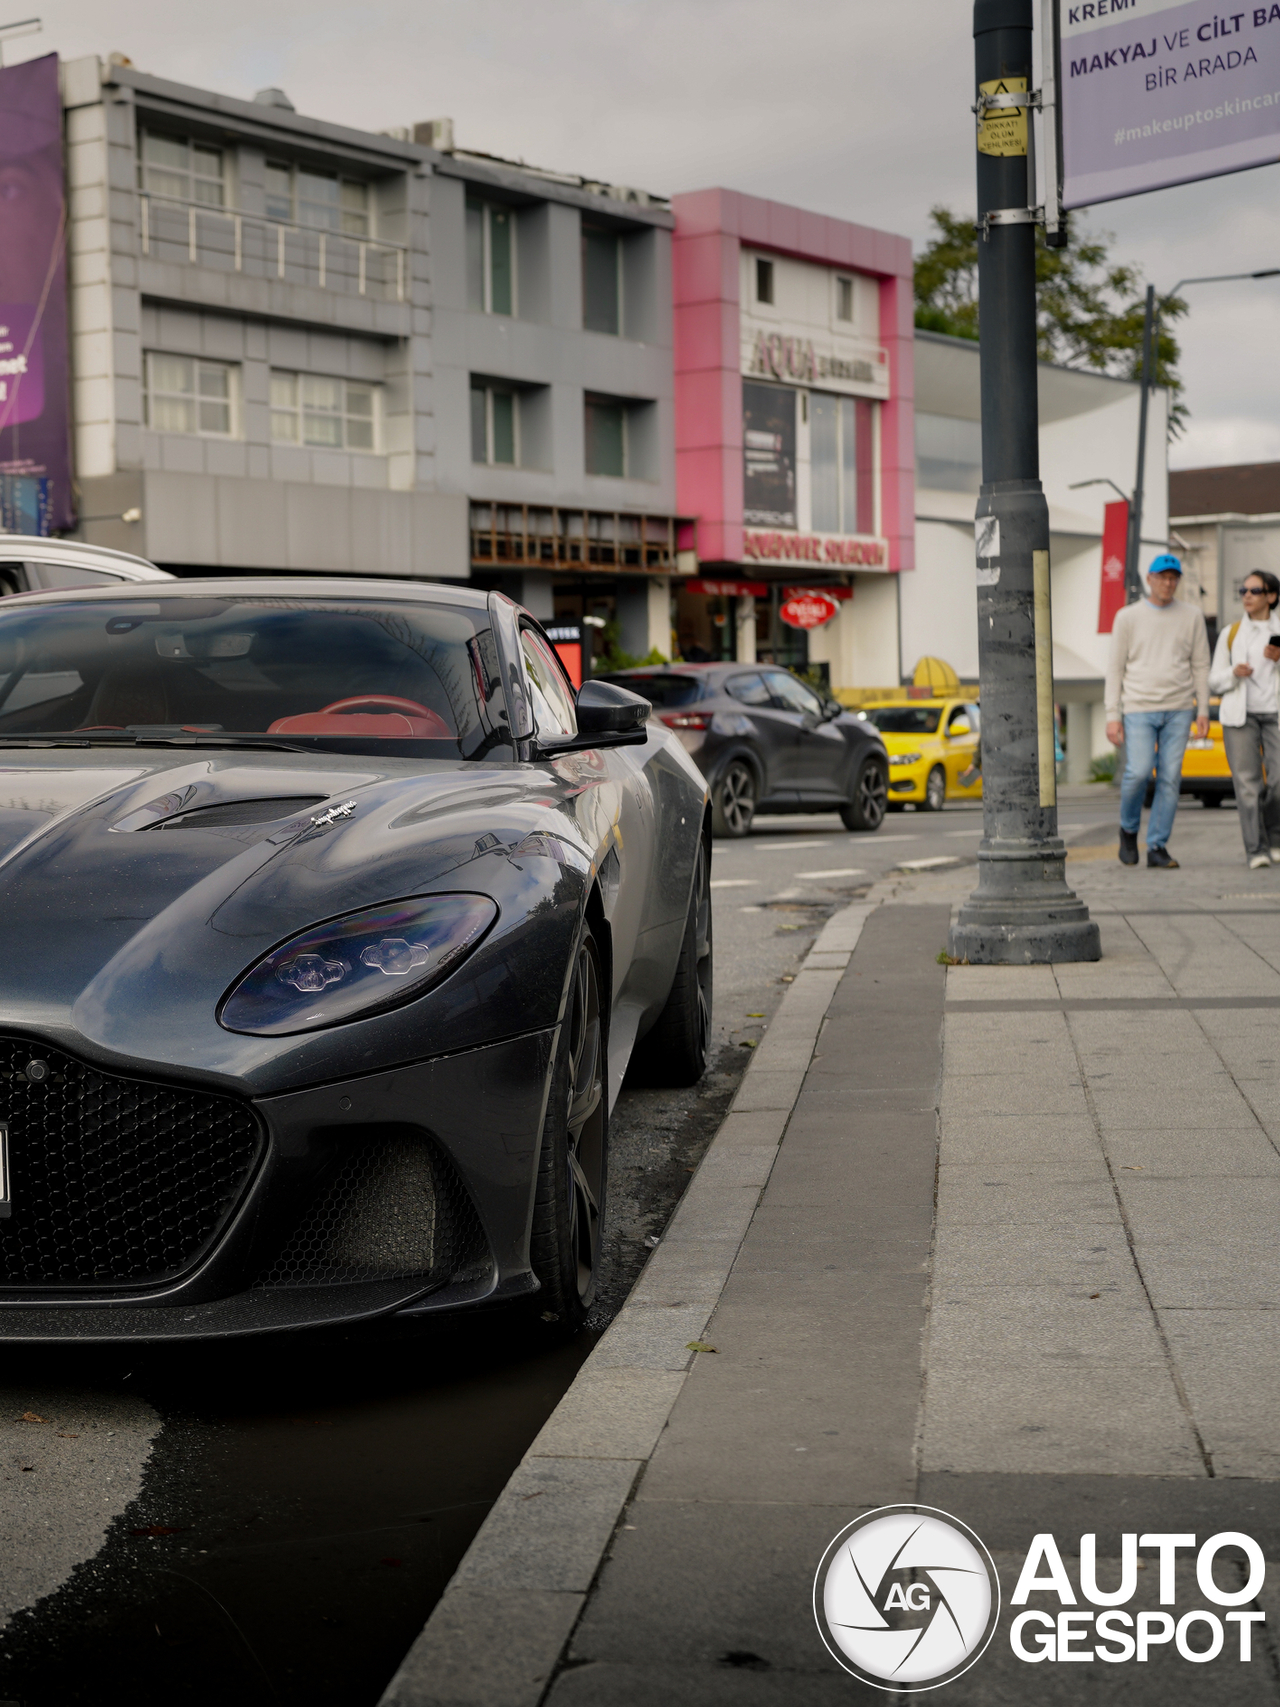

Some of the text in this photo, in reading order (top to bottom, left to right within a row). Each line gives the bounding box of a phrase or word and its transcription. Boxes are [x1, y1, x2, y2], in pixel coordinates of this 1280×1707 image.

[1070, 38, 1158, 78] MAKYAJ
[1163, 28, 1190, 51] VE
[1196, 13, 1245, 43] CİLT
[1145, 46, 1258, 92] BİR ARADA
[749, 329, 819, 382] AQUA
